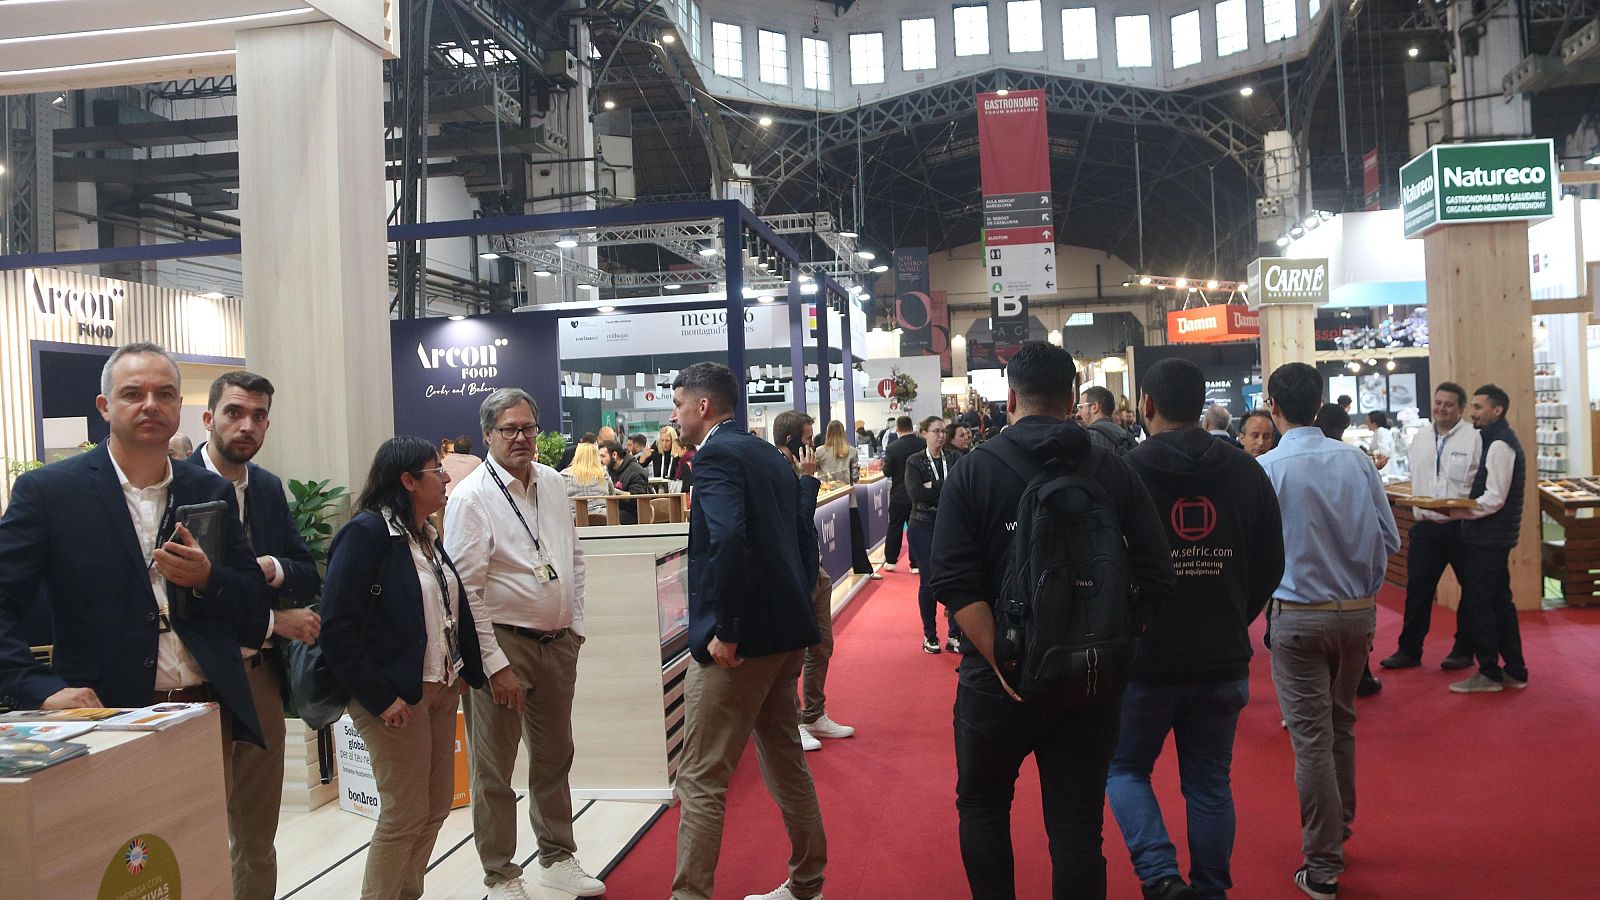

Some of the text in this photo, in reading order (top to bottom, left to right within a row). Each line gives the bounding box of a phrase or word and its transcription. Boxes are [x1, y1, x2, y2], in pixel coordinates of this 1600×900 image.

[984, 97, 1039, 110] GASTRONOMIC
[1443, 166, 1546, 188] Natureco
[1403, 175, 1434, 206] Natureco
[1445, 194, 1492, 205] GASTRONOMIA
[1511, 191, 1546, 201] SALUDABLE
[1508, 201, 1546, 211] GASTRONOMY
[1265, 265, 1325, 292] CARNÉ
[32, 273, 114, 321] Arcon
[998, 296, 1023, 317] B
[681, 306, 754, 327] me196
[78, 321, 114, 339] FOOD
[681, 326, 721, 336] montagud
[998, 325, 1023, 337] A C
[1177, 316, 1217, 334] Damm
[417, 341, 498, 369] Arcon
[461, 366, 498, 379] FOOD
[451, 383, 466, 395] and
[1170, 545, 1233, 558] w.sefric.com
[1195, 560, 1223, 569] Catering
[1185, 568, 1220, 576] equipment
